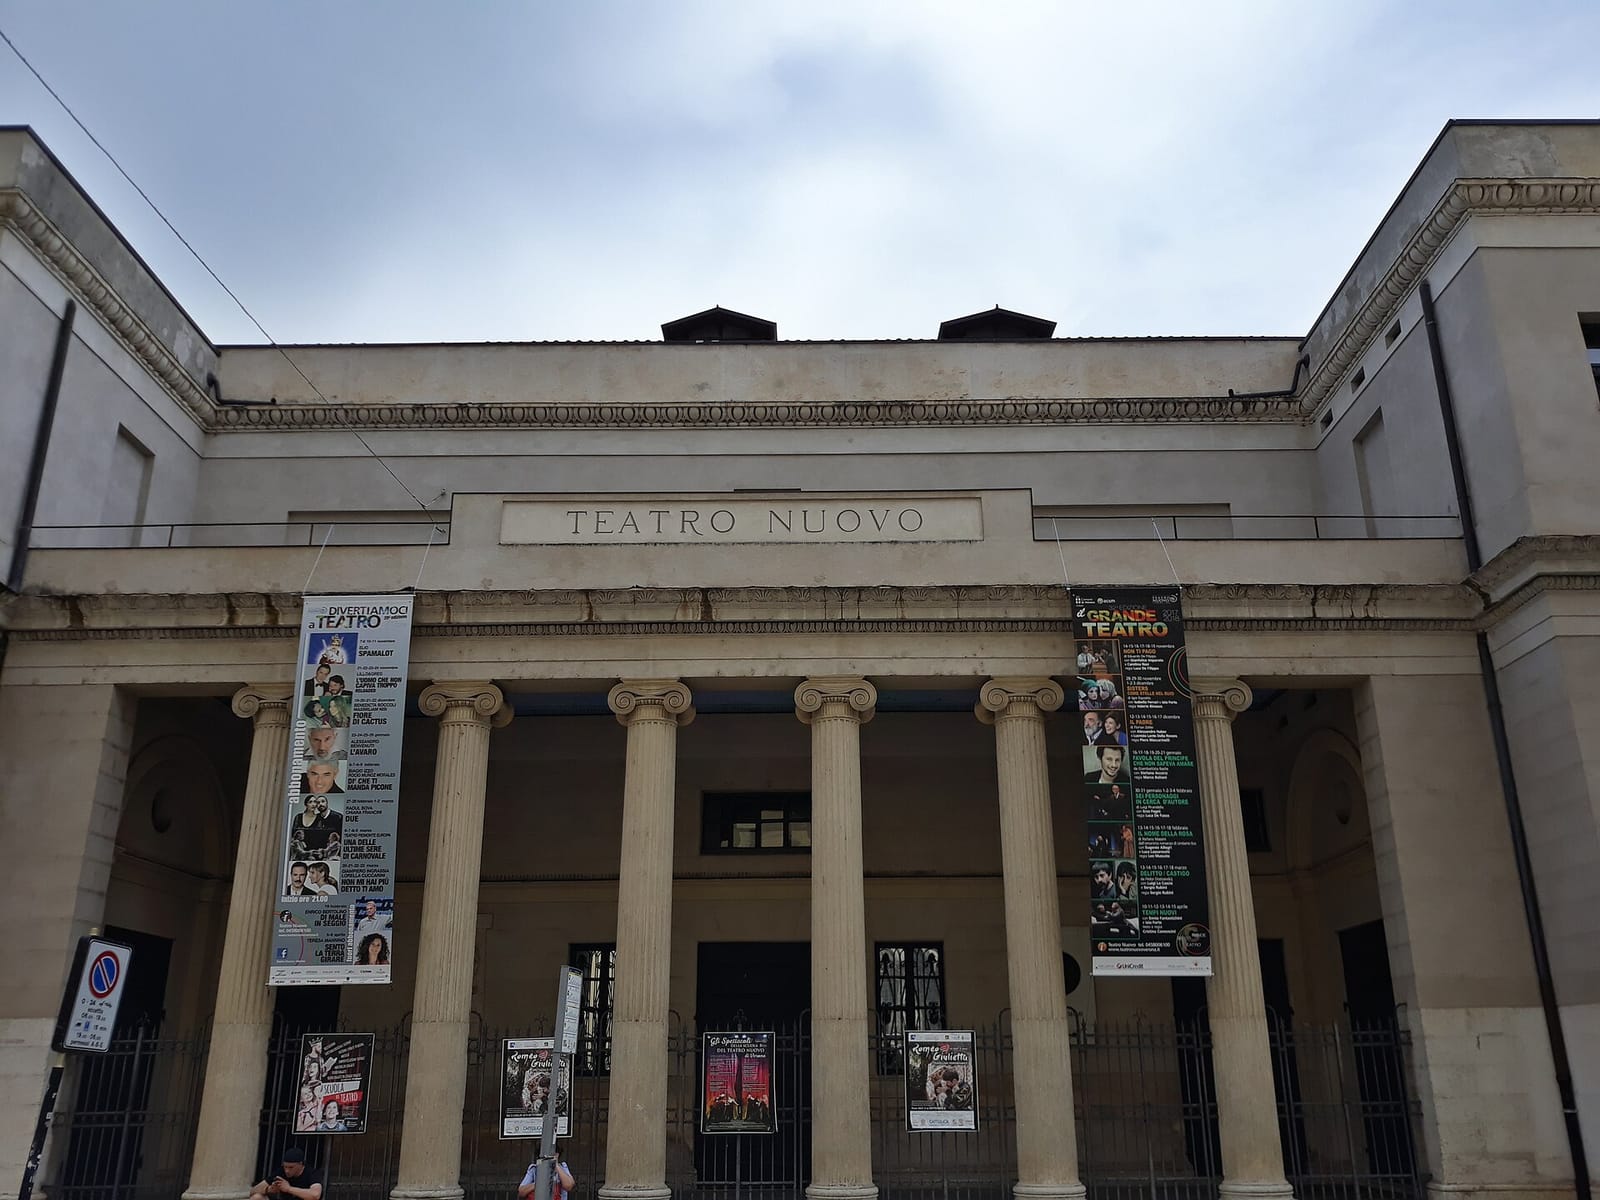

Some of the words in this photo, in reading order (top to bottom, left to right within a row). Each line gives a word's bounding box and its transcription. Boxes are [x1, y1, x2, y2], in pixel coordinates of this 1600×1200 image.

[566, 509, 736, 536] TEATRO
[768, 508, 923, 534] NUOVO
[329, 606, 408, 616] DIVERTIAMOCI
[1086, 610, 1158, 622] GRANDE
[316, 615, 381, 629] TEATRO
[1082, 622, 1169, 638] TEATRO
[288, 720, 306, 804] abbonamento
[912, 1042, 940, 1057] Romeo
[933, 1052, 968, 1061] Giulietta
[511, 1050, 538, 1065] Romeo
[324, 1083, 345, 1094] SCUOLA
[340, 1092, 358, 1102] TEATRO
